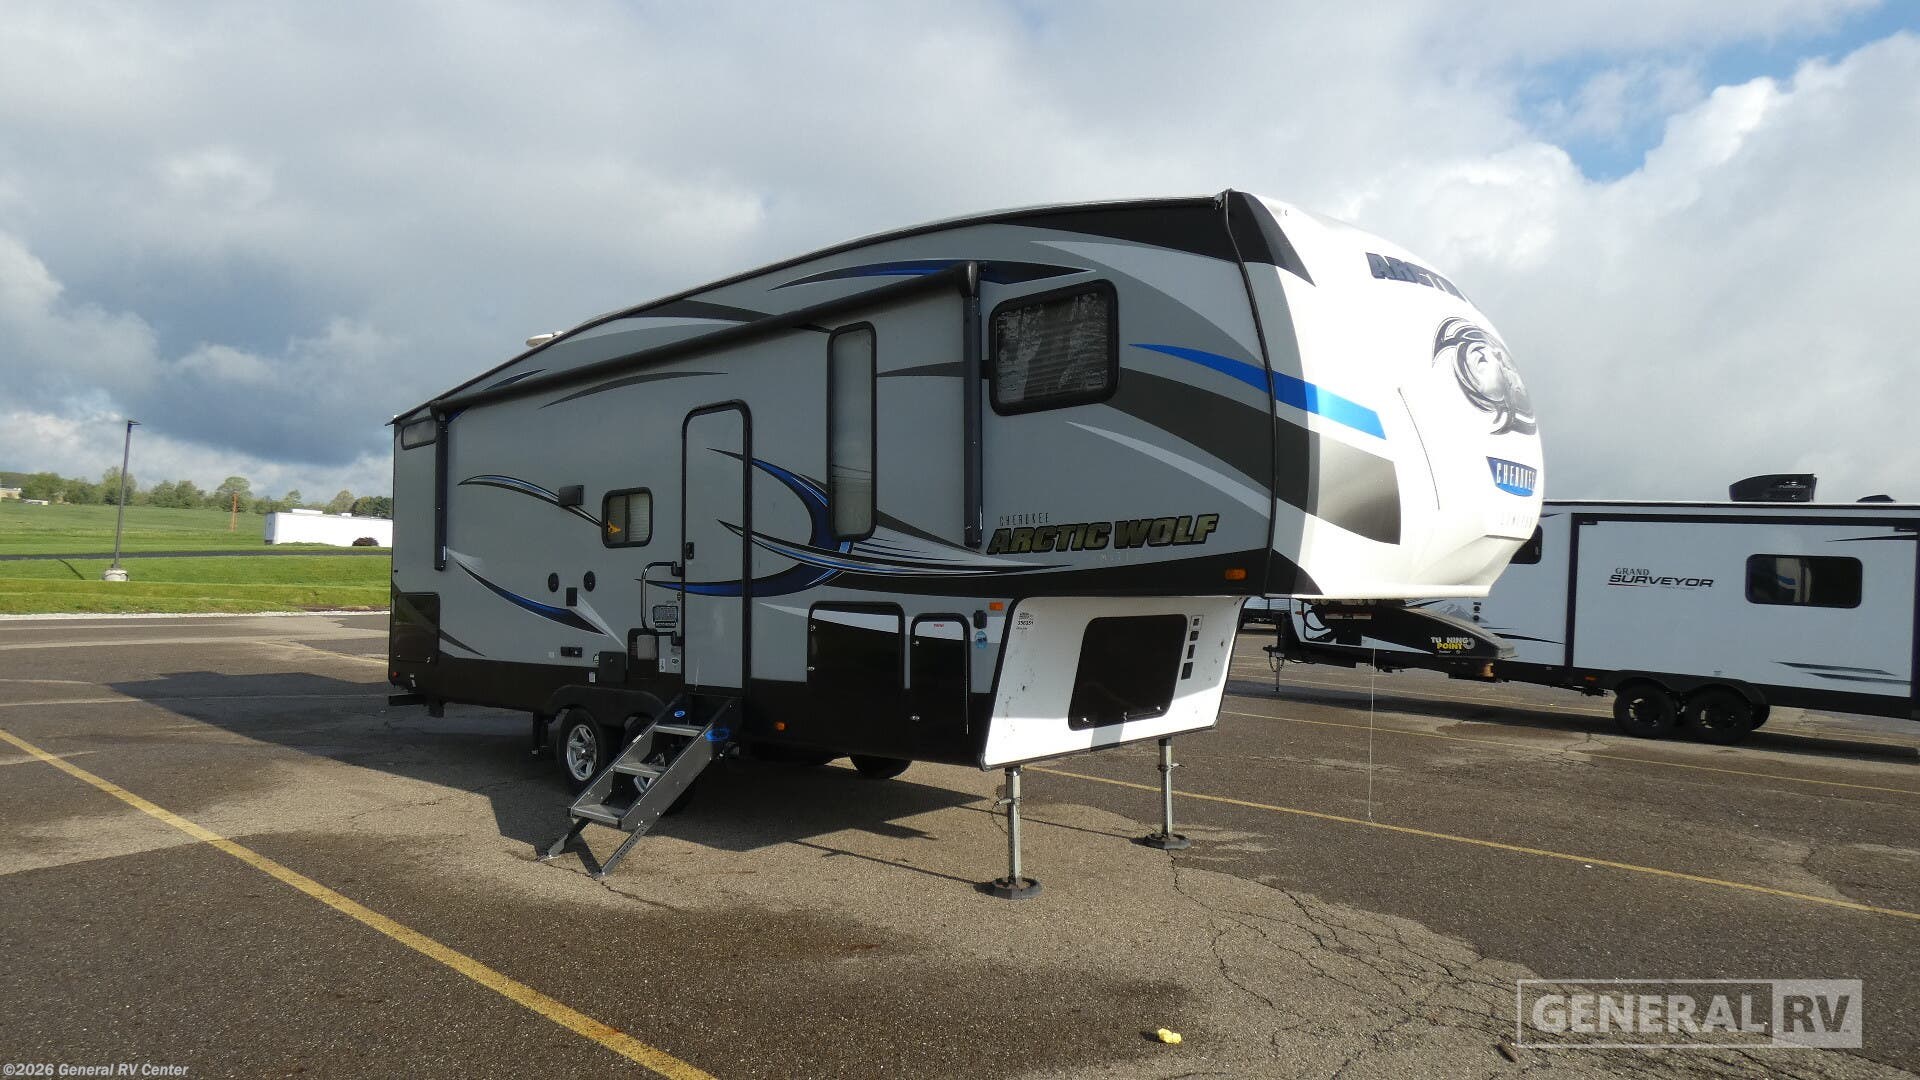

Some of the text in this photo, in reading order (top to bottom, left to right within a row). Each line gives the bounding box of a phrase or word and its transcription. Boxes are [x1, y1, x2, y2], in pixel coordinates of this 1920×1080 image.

[987, 513, 1219, 554] ARCTIC WOLF
[1615, 567, 1650, 576] GRAND
[1609, 574, 1714, 588] SURVEYOR
[1436, 642, 1463, 650] POINT
